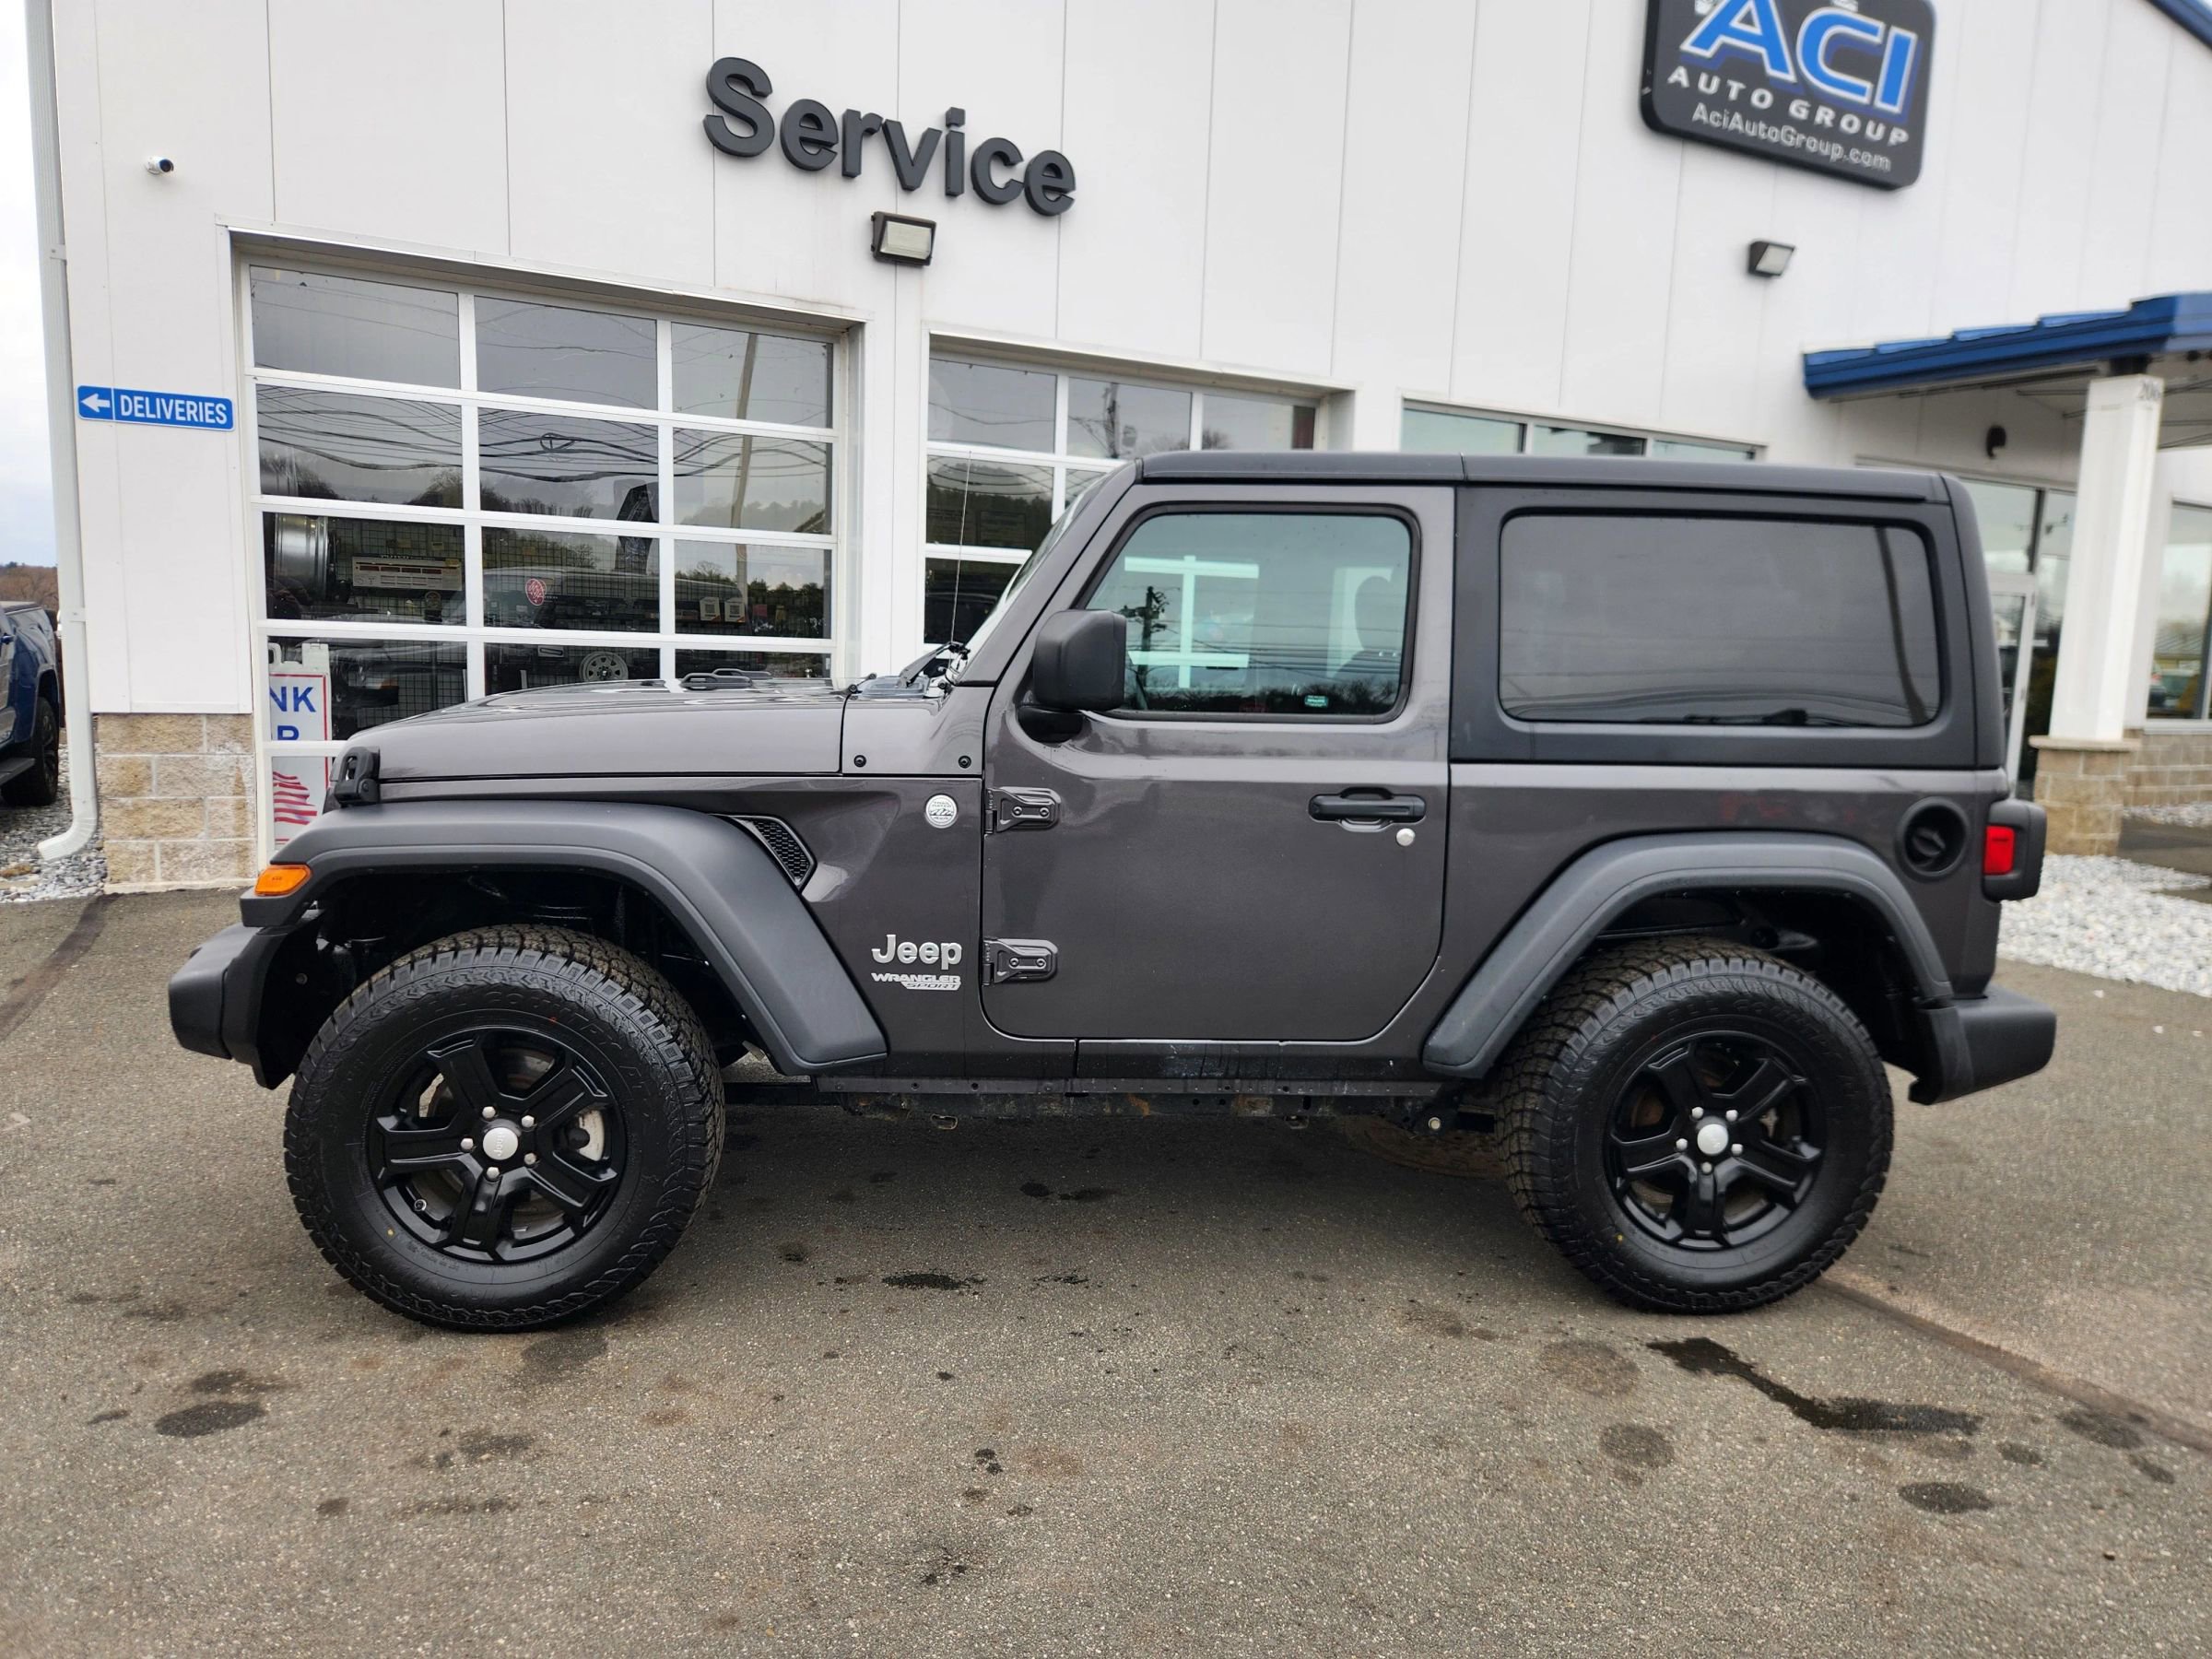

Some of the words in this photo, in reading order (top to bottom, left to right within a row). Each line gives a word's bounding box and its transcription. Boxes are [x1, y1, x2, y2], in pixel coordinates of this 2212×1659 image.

[1679, 0, 1918, 114] ACI
[703, 56, 1077, 217] Service
[1667, 65, 1774, 110] AUTO
[1788, 99, 1910, 147] GROUP
[1691, 103, 1892, 173] AciAutoGroup.com
[120, 394, 228, 425] DELIVERIES
[871, 934, 962, 971] Jeep
[871, 972, 961, 982] WRANGLER
